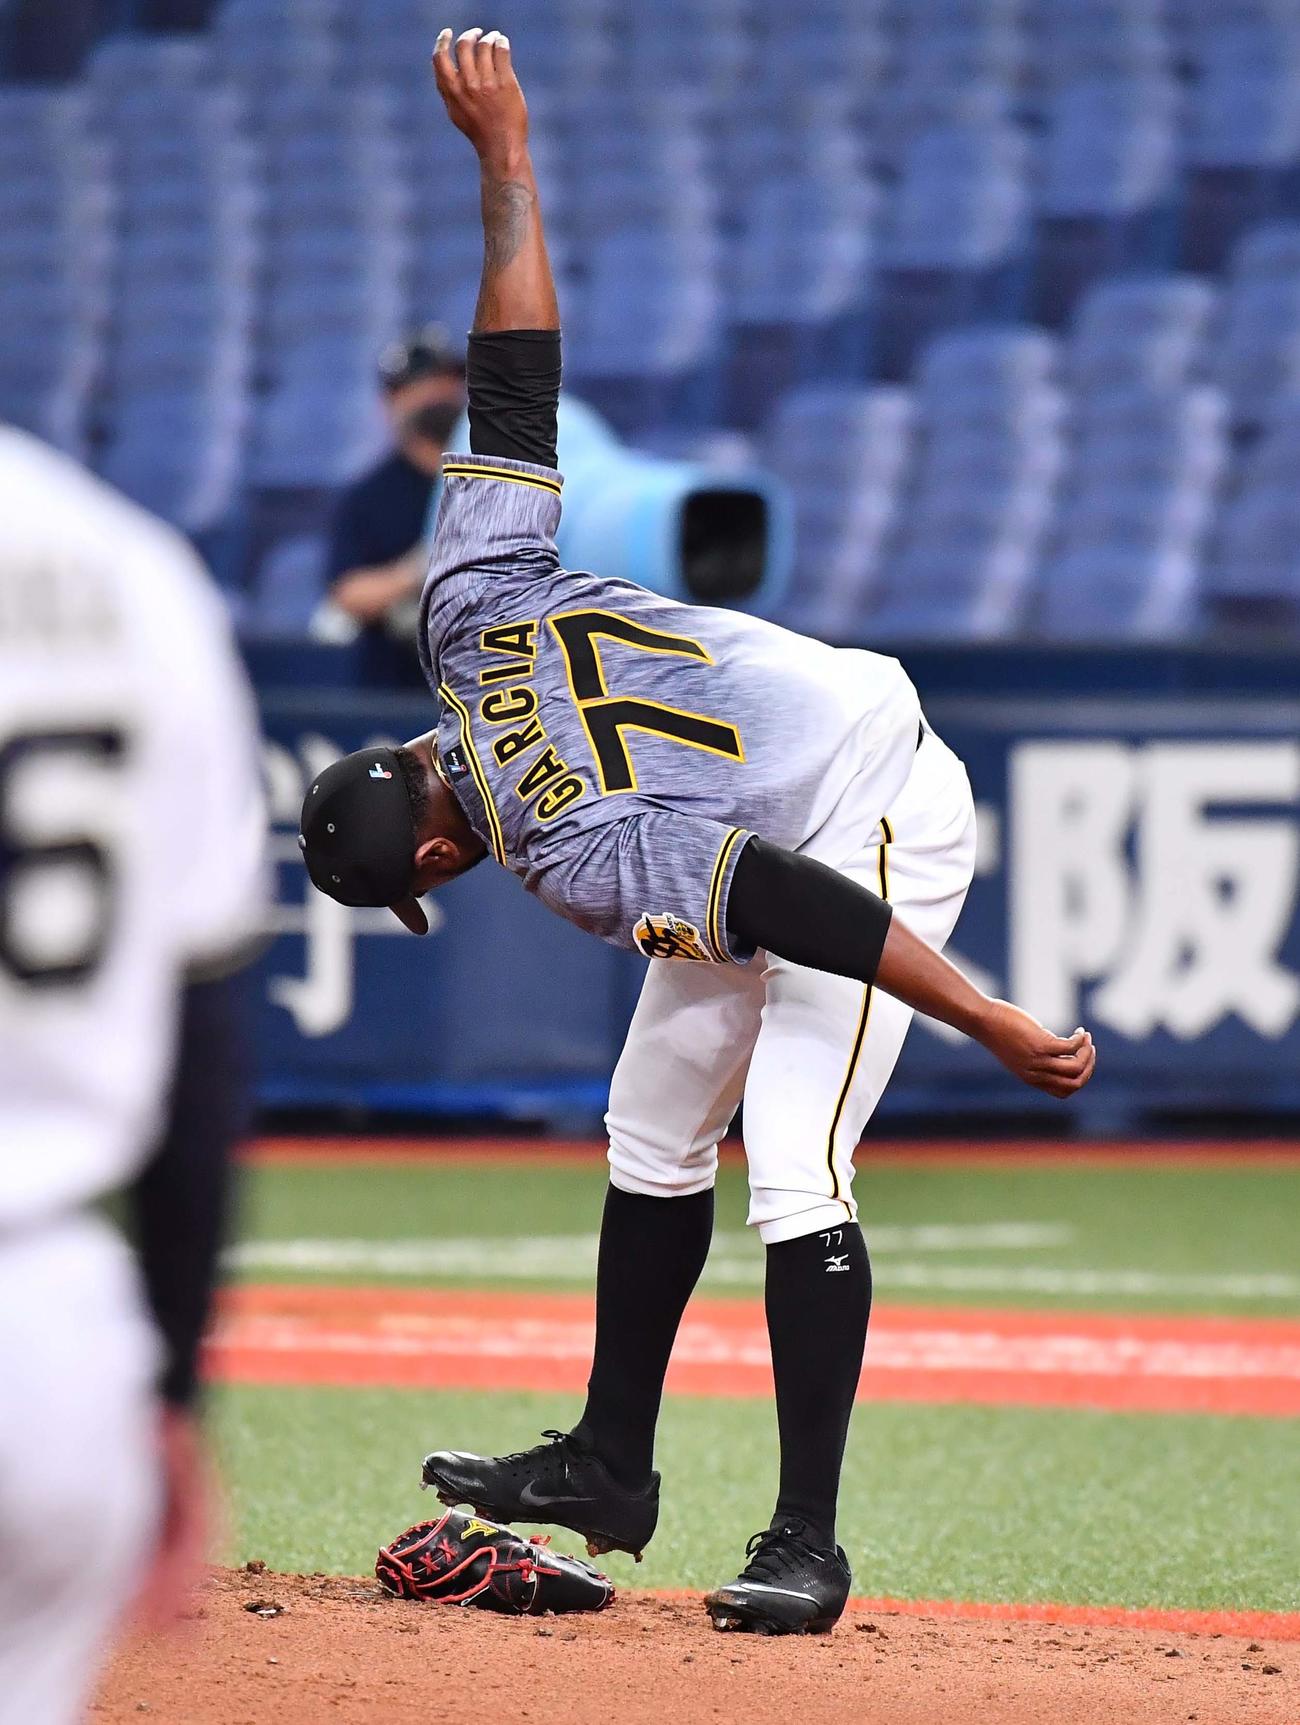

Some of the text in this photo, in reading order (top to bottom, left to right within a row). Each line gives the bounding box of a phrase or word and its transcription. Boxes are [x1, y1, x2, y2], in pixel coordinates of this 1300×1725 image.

[479, 619, 587, 823] GARCIA
[547, 608, 746, 797] 77
[818, 1229, 844, 1247] 77
